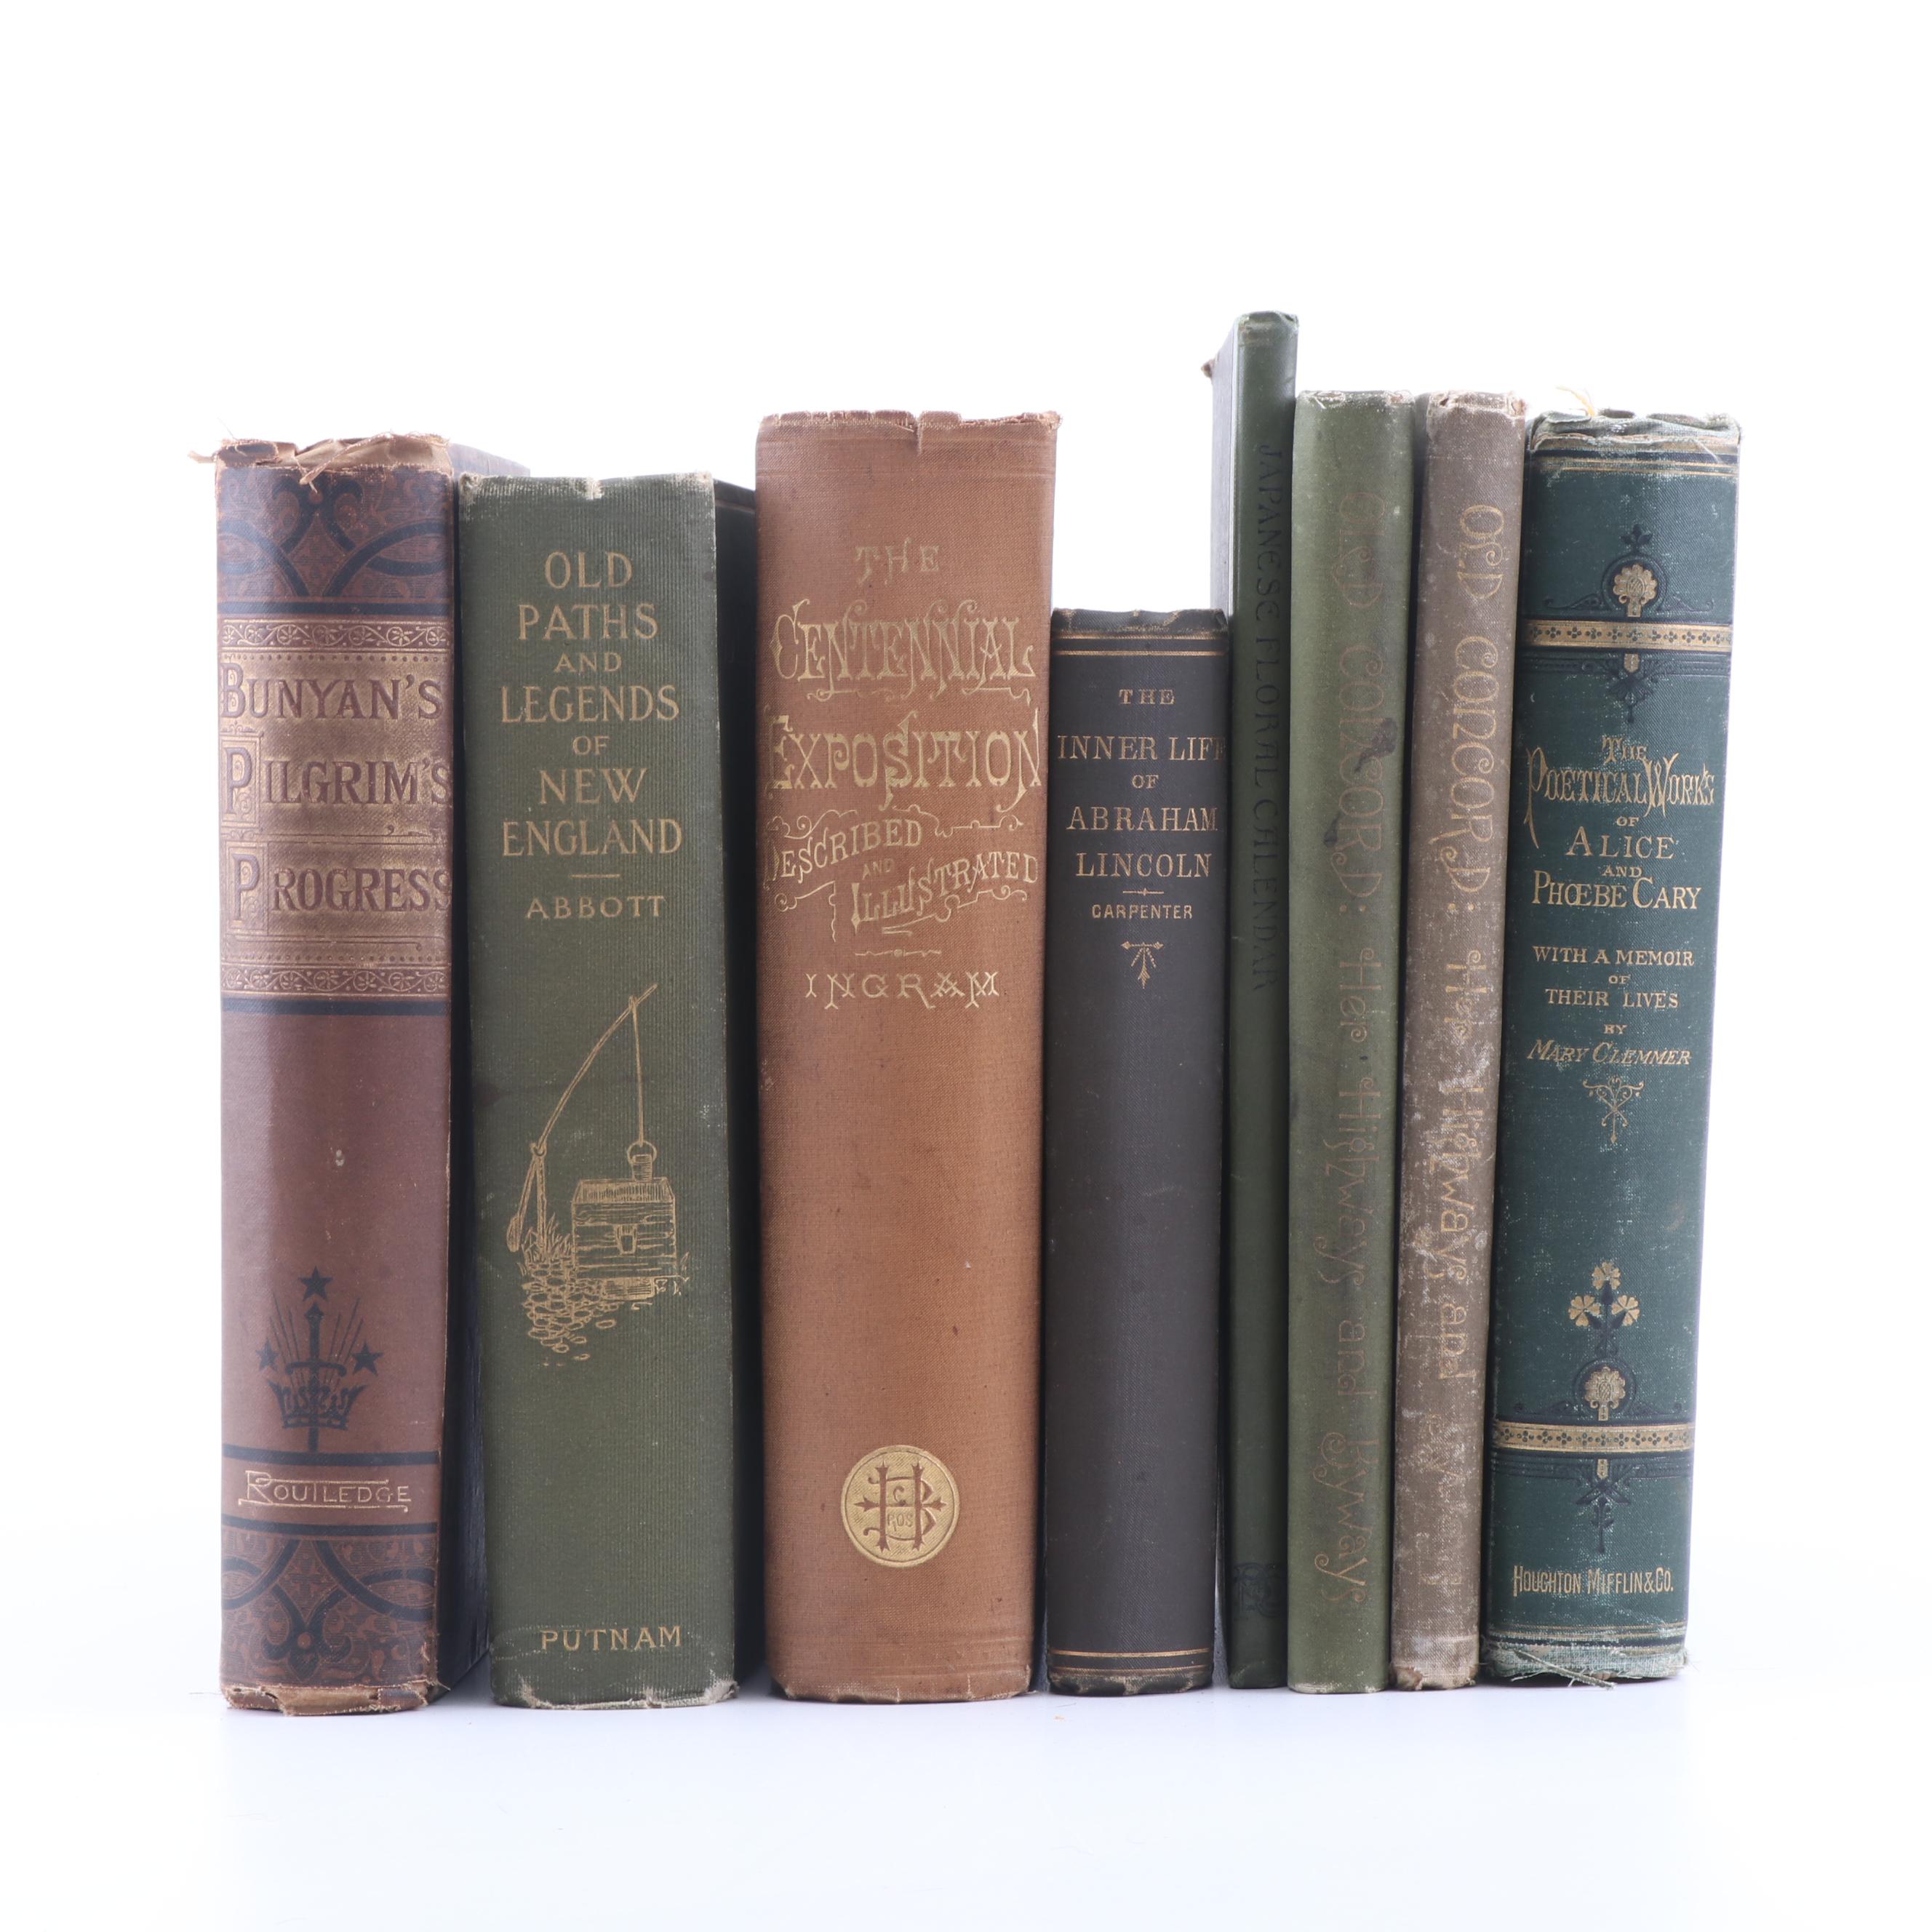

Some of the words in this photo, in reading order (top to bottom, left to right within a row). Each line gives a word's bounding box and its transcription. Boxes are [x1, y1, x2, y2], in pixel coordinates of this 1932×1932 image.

[1256, 444, 1282, 623] JAPANESE
[1333, 492, 1385, 607] OLD
[855, 538, 940, 585] THE
[1456, 505, 1505, 599] OLD
[545, 551, 633, 589] OLD
[518, 603, 658, 641] PATHS
[554, 651, 622, 673] AND
[771, 599, 1036, 699] CENTENNIAL
[219, 663, 444, 720] BUNYAN'S
[500, 684, 680, 724] LEGENDS
[1119, 689, 1175, 705] THE
[572, 735, 611, 756] OF
[765, 708, 1042, 813] EXPOSITION
[1057, 735, 1158, 762] INNER
[1167, 736, 1226, 762] LIFE
[223, 746, 453, 815] PILGRIM'S
[539, 767, 649, 805] NEW
[1132, 774, 1159, 789] OF
[1066, 806, 1218, 831] ABRAHAM
[1616, 815, 1640, 827] OF
[503, 818, 683, 858] ENGLAND
[765, 818, 922, 890] DESCRIBED
[1565, 826, 1675, 858] ALICE
[862, 857, 895, 880] AND
[1075, 853, 1213, 879] LINCOLN
[1602, 866, 1642, 879] AND
[232, 853, 452, 925] PROGRESS
[851, 851, 1039, 934] ILLUSTRATED
[1632, 877, 1702, 910] CARY
[525, 895, 666, 920] ABBOTT
[1092, 903, 1193, 919] CARPENTER
[1533, 946, 1587, 964] WITH
[1594, 949, 1610, 965] A
[1616, 950, 1695, 967] MEMOIR
[805, 971, 999, 1010] INGRAM
[1608, 974, 1631, 985] OF
[1545, 989, 1610, 1007] THEIR
[1624, 993, 1679, 1008] LIVES
[1604, 1023, 1627, 1035] BY
[1528, 1039, 1589, 1062] MARY
[1592, 1042, 1692, 1066] CLEMMER
[1513, 1565, 1582, 1597] HOUGHTON
[540, 1624, 683, 1651] PUTNAM
